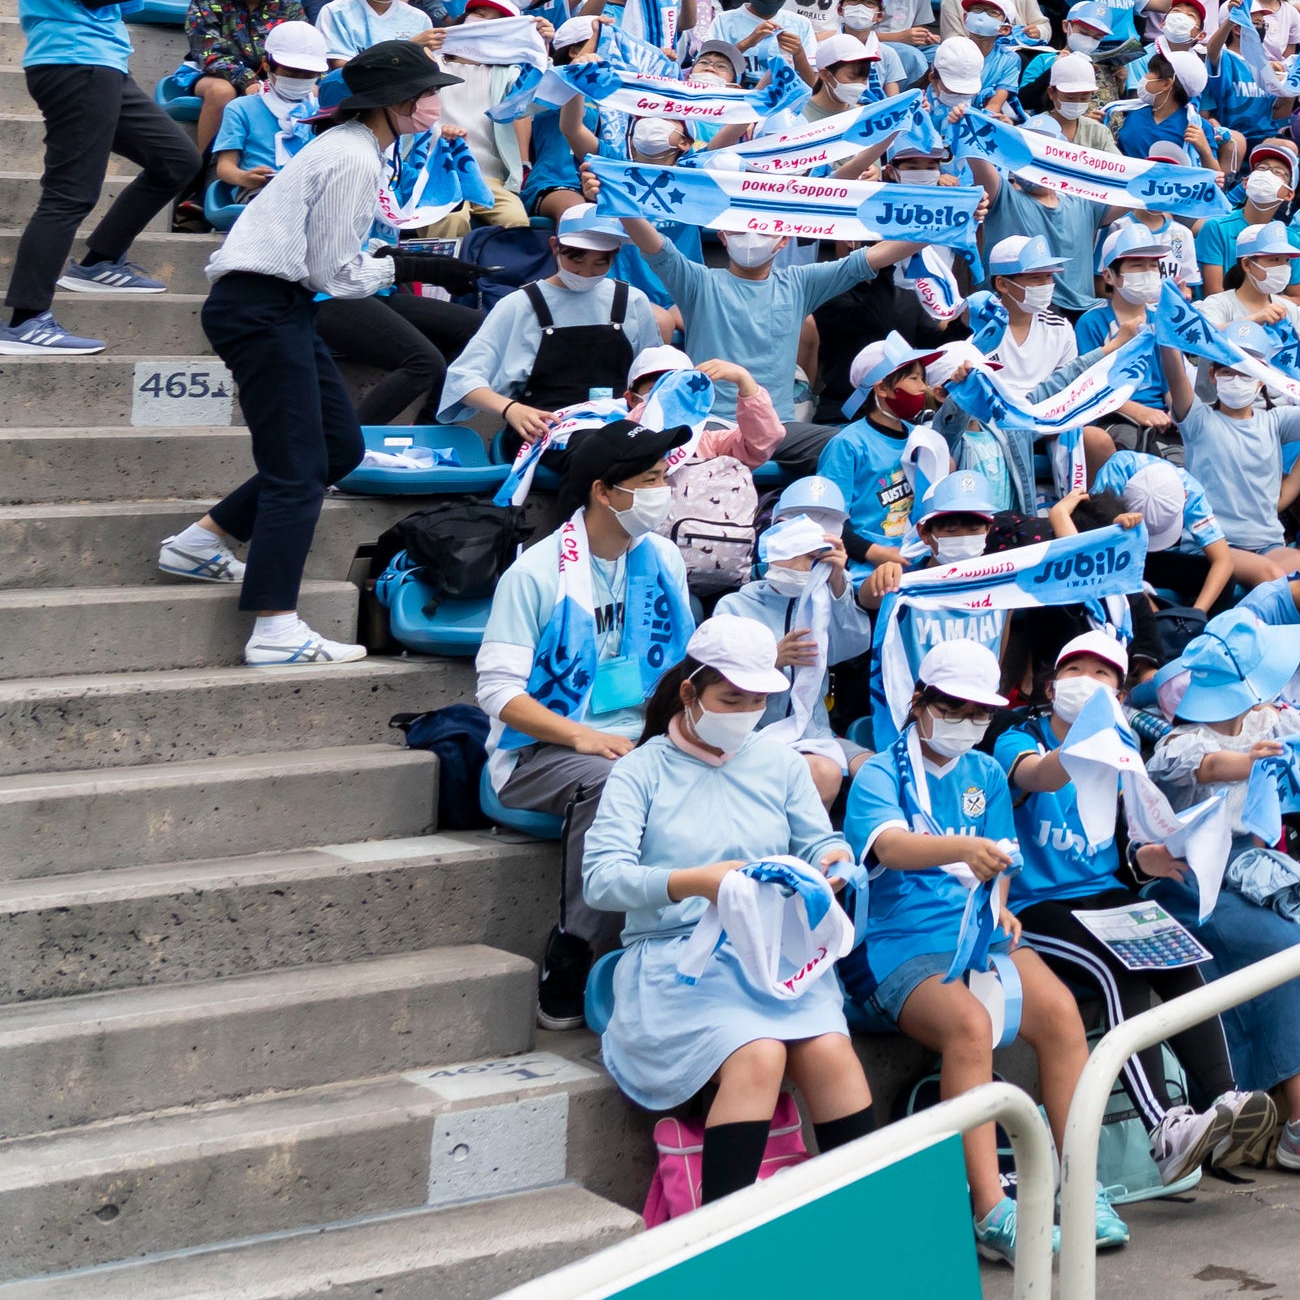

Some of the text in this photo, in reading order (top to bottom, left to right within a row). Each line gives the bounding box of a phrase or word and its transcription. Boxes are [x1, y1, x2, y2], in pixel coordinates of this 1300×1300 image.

[796, 9, 827, 21] MORALE
[1233, 82, 1267, 98] YAMA
[637, 97, 727, 118] Go Beyond
[772, 150, 829, 171] Beyond
[1141, 180, 1216, 204] Júbilo
[875, 202, 971, 229] Júbilo
[747, 217, 835, 237] Go Beyond
[880, 487, 902, 507] JUST
[916, 614, 999, 646] YAMAH
